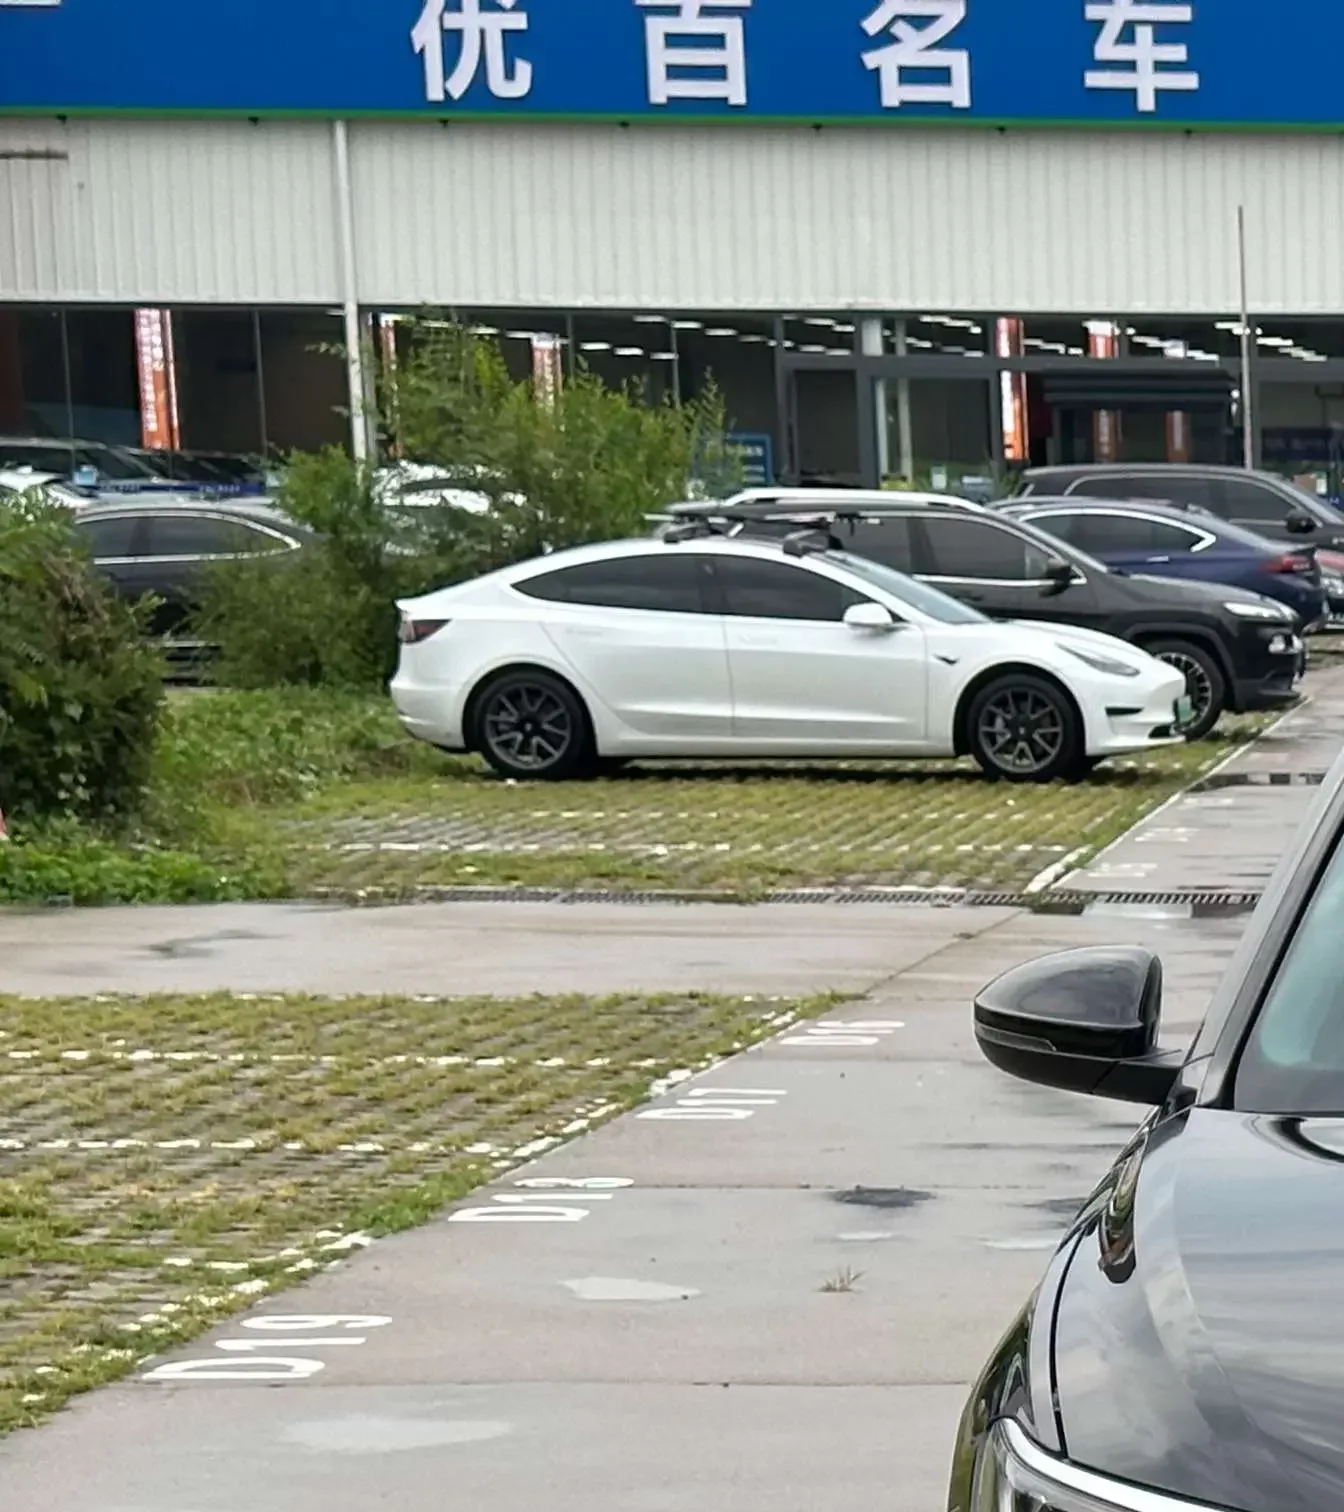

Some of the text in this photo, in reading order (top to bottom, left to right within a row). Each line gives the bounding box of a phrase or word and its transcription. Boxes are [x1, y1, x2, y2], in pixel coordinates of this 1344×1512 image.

[410, 0, 1200, 112] 优百名车
[141, 1313, 394, 1380] D19
